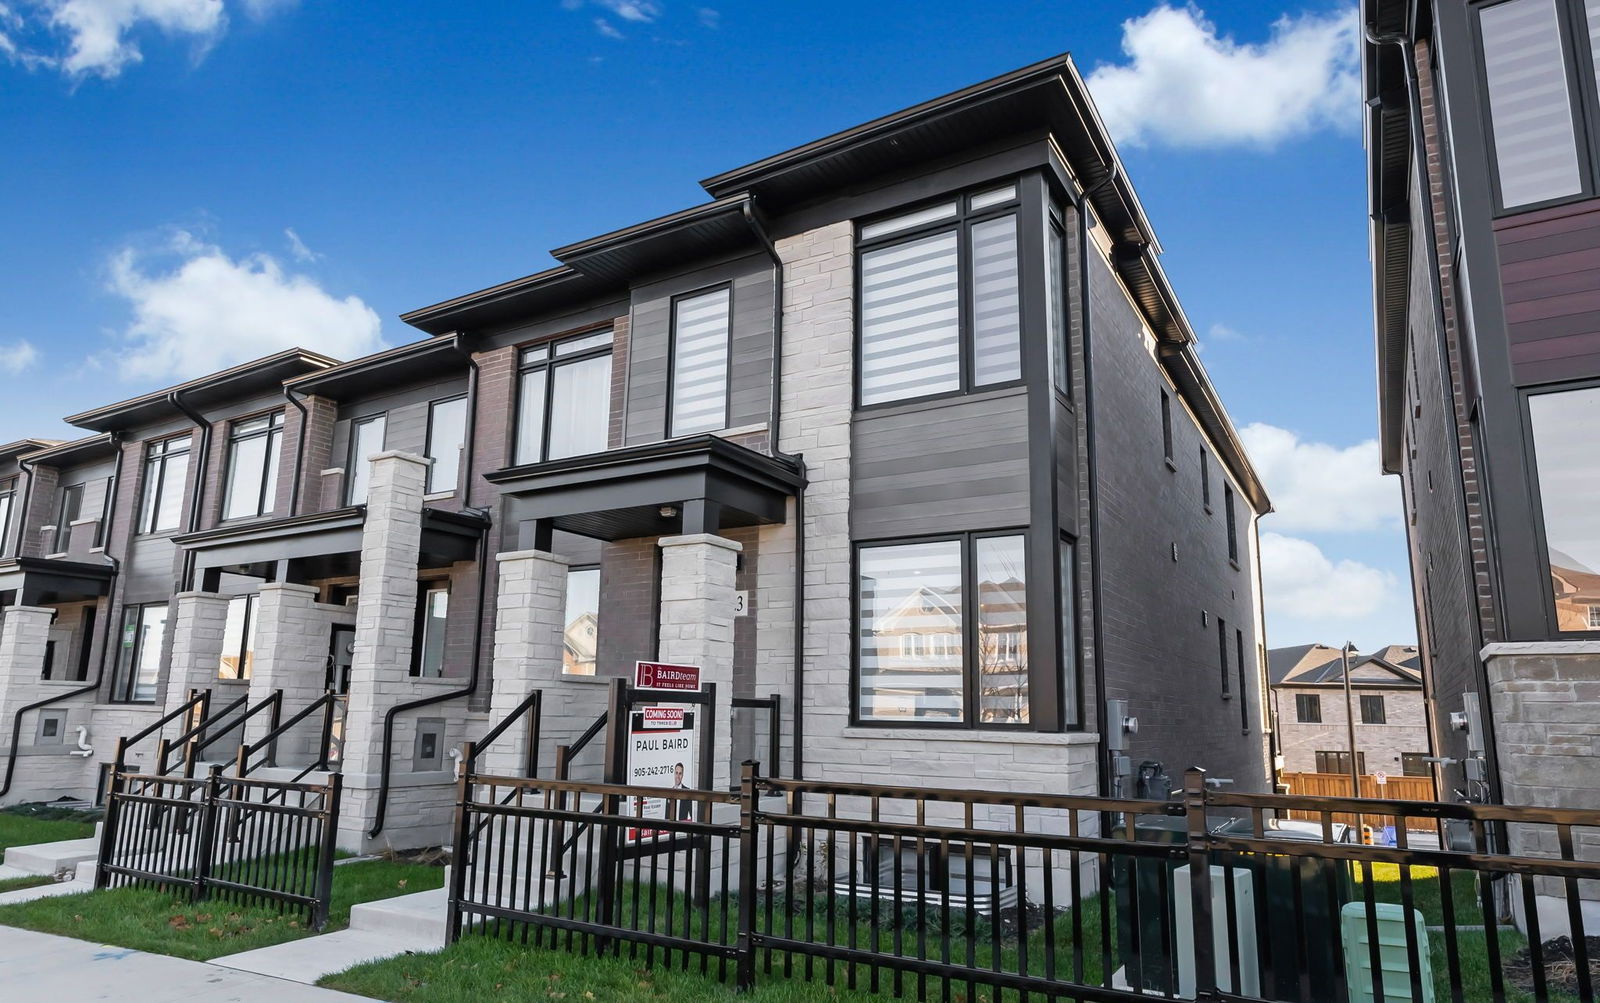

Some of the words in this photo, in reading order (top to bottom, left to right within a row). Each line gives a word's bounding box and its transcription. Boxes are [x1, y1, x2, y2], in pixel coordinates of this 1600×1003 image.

[645, 709, 667, 719] COMING
[636, 740, 659, 751] PAUL
[662, 738, 689, 750] BAIRD
[634, 765, 674, 777] 905-242-2716
